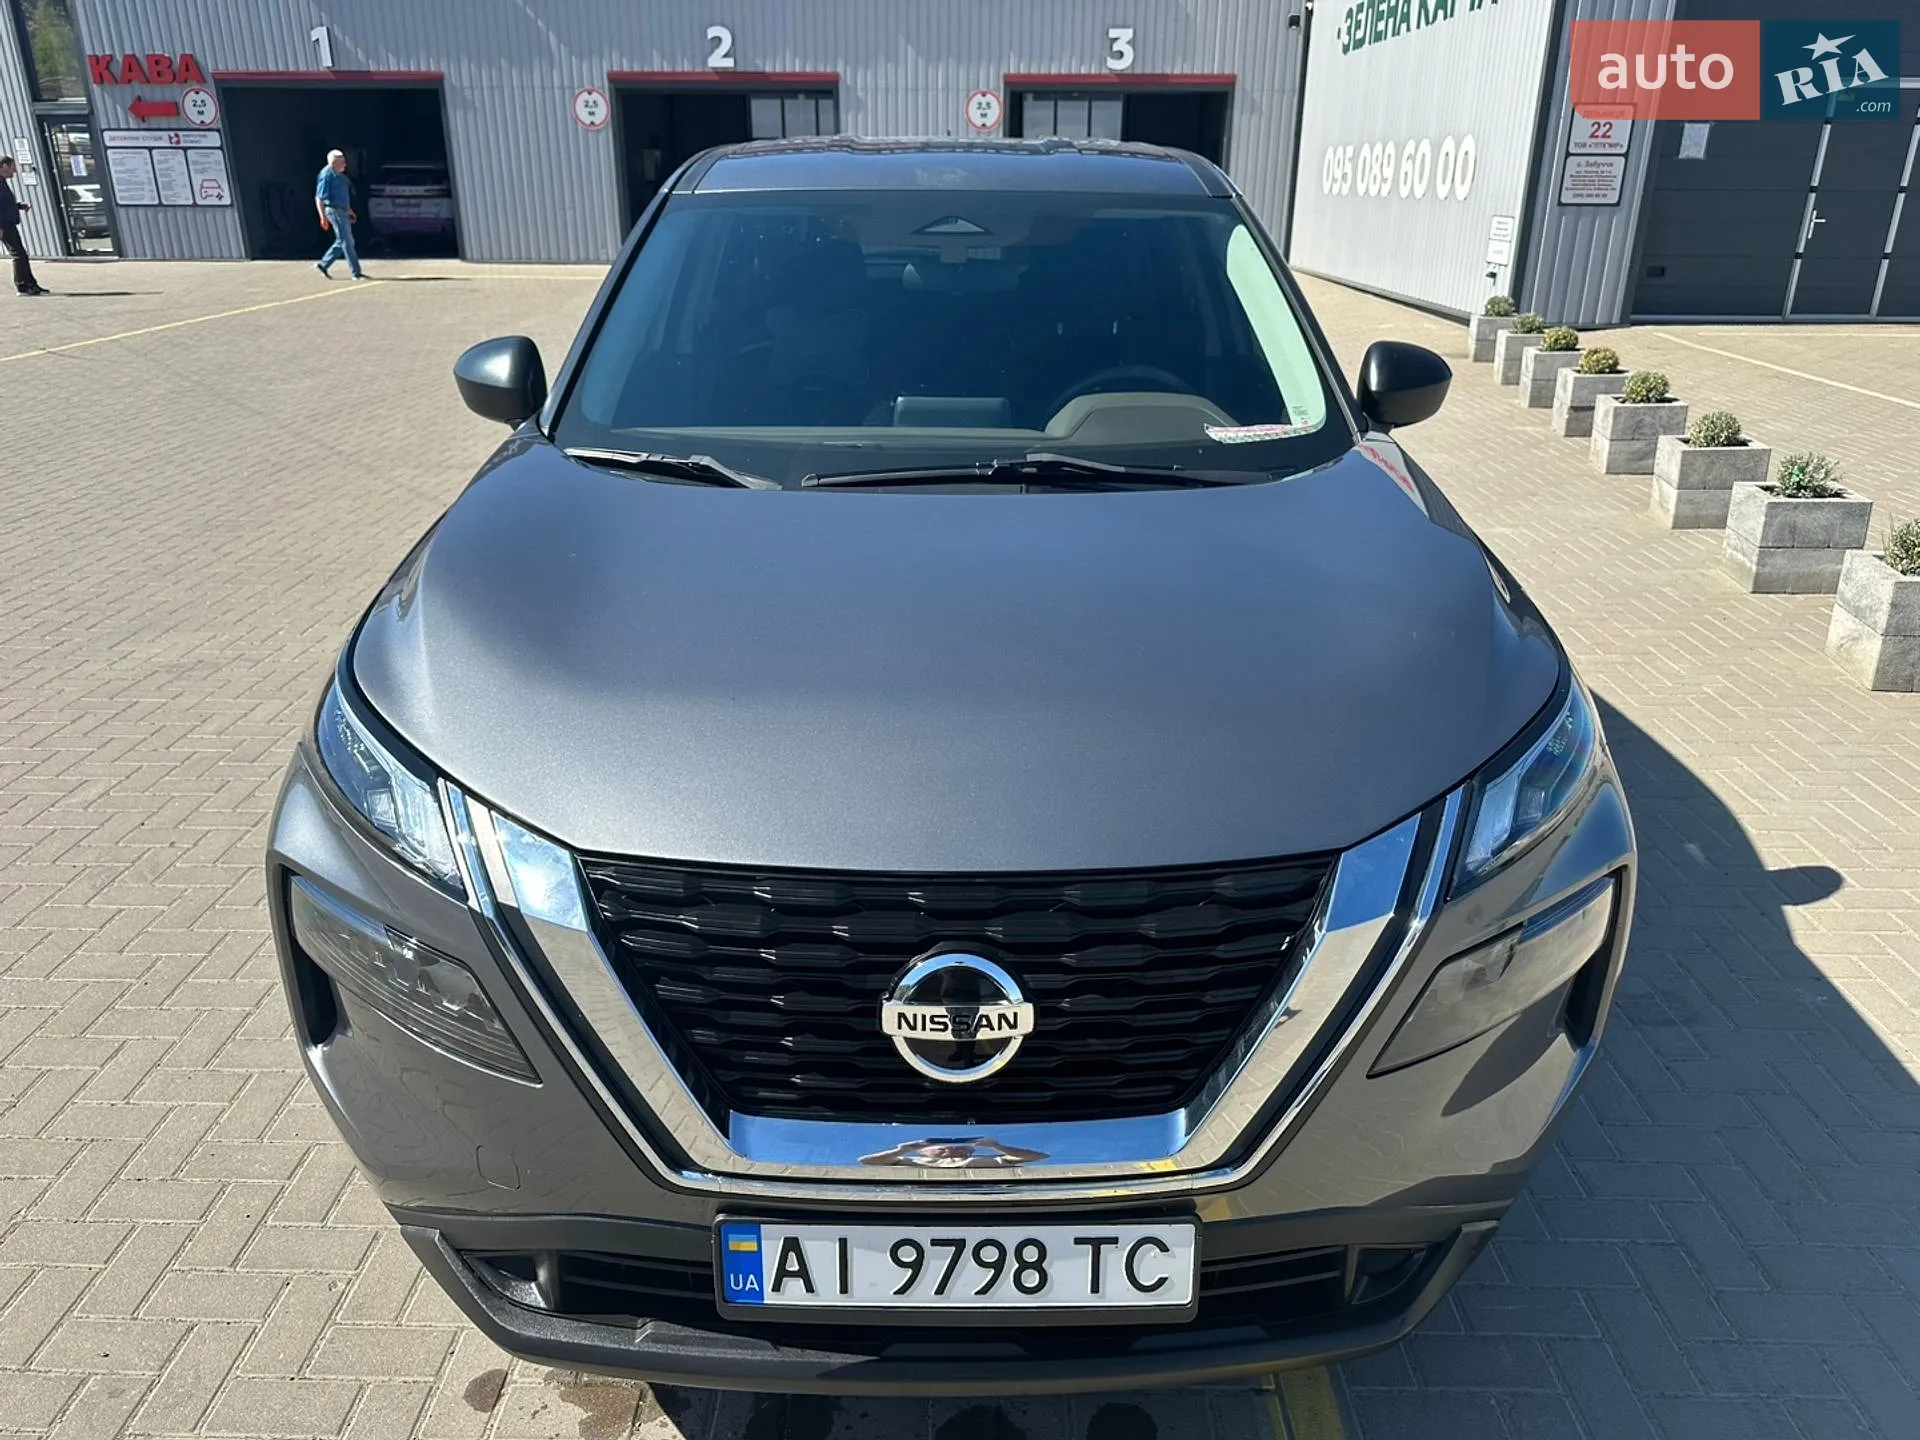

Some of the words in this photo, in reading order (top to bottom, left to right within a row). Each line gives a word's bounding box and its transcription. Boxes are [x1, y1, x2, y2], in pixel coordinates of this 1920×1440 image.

[311, 25, 333, 68] 1
[706, 25, 735, 68] 2
[1341, 0, 1411, 55] ЗЕЛЕНА
[88, 52, 206, 85] КАВА
[1106, 28, 1134, 70] 3
[1588, 121, 1613, 139] 22
[1322, 145, 1355, 196] 095
[1356, 140, 1396, 198] 089
[1400, 138, 1432, 200] 60
[1436, 133, 1477, 201] 00
[897, 1012, 1018, 1032] NISSAN
[730, 1274, 760, 1291] UA
[770, 1236, 848, 1294] AI
[888, 1237, 1049, 1296] 9798
[1073, 1236, 1171, 1294] TC
